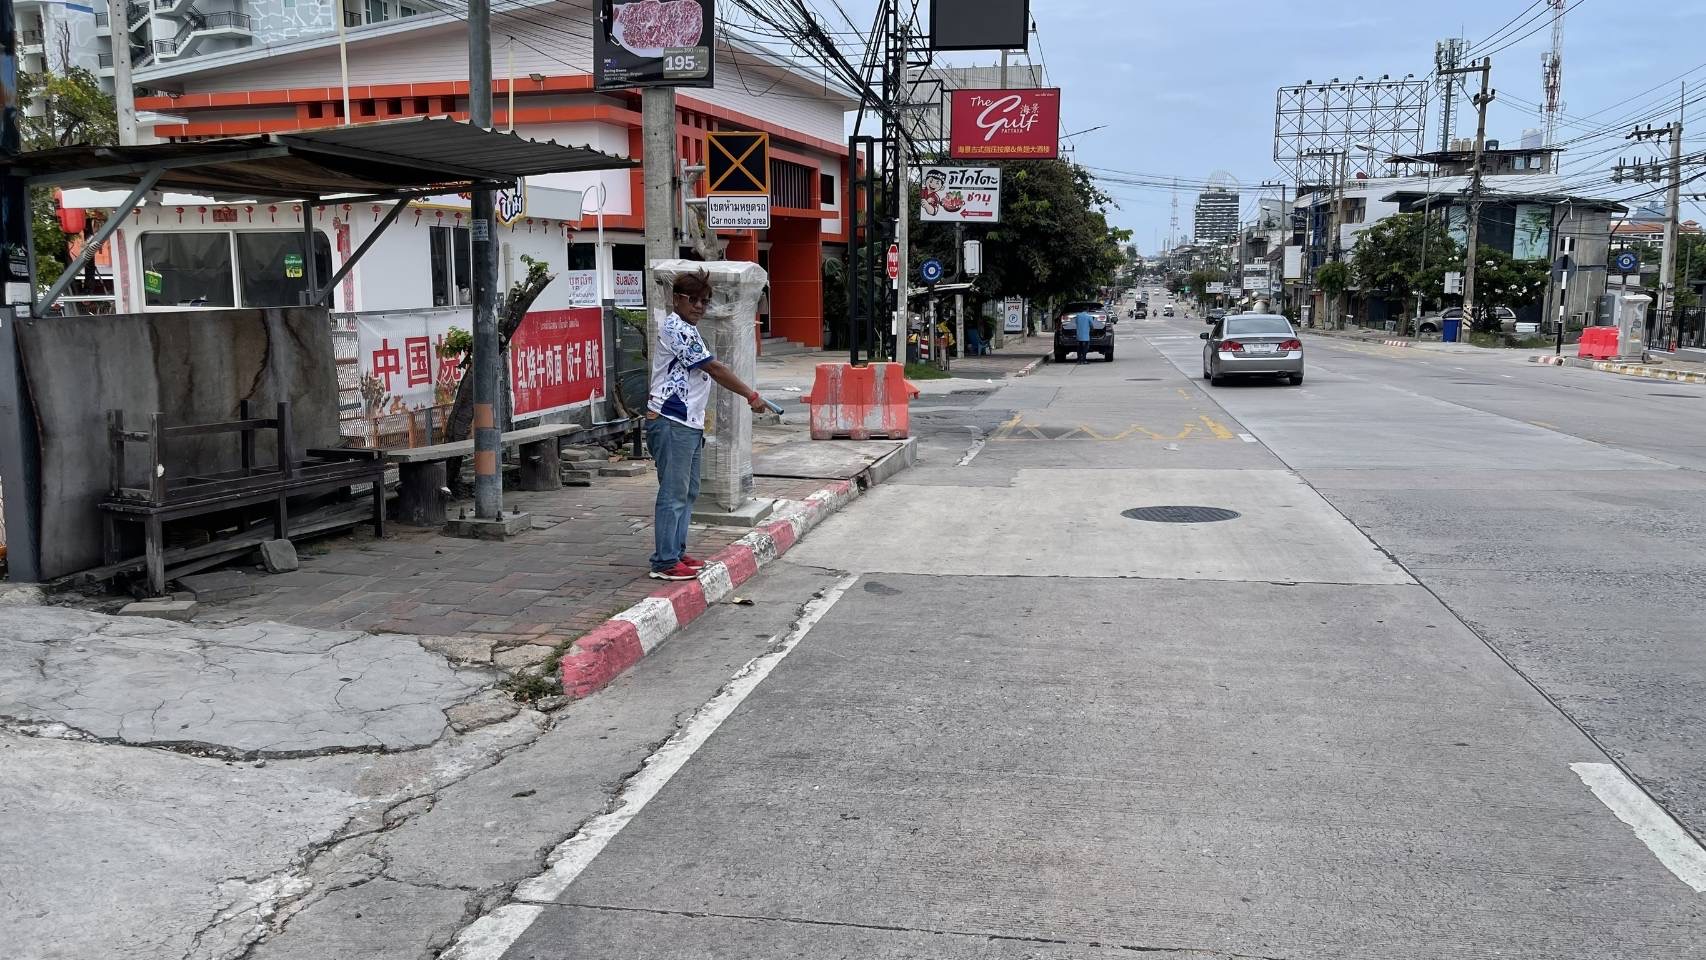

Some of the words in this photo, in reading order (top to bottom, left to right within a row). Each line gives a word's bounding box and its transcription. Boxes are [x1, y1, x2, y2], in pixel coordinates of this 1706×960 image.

[971, 96, 994, 107] The
[976, 95, 1039, 141] Gulf
[710, 199, 766, 215] เขตห้ามหยุดรถ
[711, 216, 723, 225] Car
[737, 217, 751, 226] stop
[517, 344, 563, 389] 红烧牛肉面
[566, 341, 582, 383] 饺子
